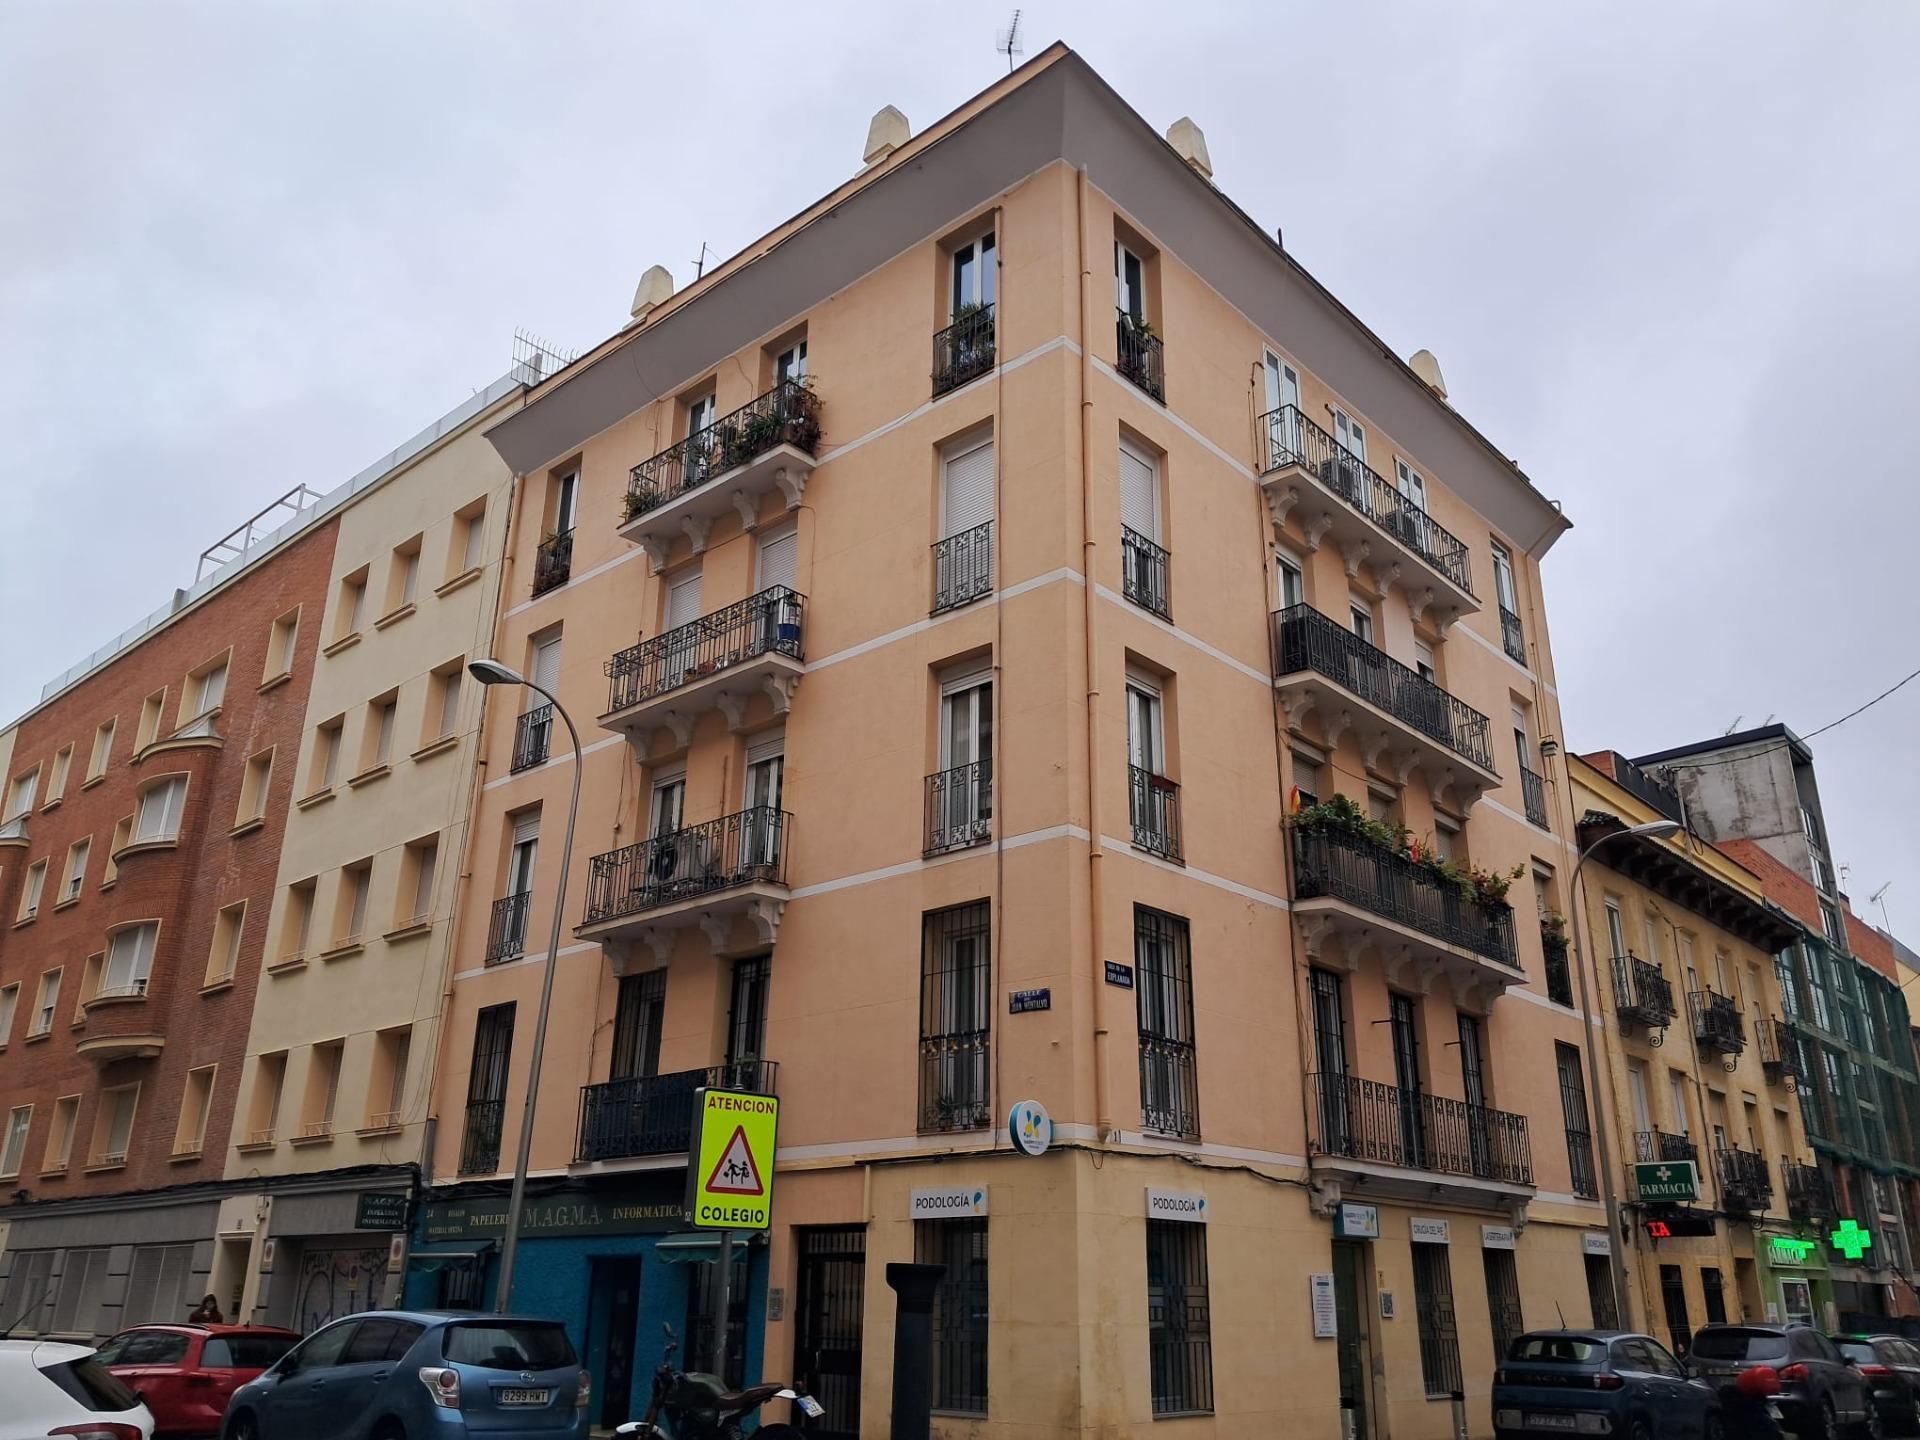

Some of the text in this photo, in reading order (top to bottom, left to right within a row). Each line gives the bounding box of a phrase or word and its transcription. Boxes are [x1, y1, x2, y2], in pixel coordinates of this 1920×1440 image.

[708, 1096, 775, 1114] ATENCION
[1640, 1183, 1693, 1195] FARMACIA
[915, 1192, 970, 1209] PODOLOGÍA
[470, 1214, 511, 1226] PAPELERI
[613, 1205, 683, 1219] INFORMATICA
[701, 1206, 764, 1223] COLEGIO
[503, 1391, 527, 1401] 8299
